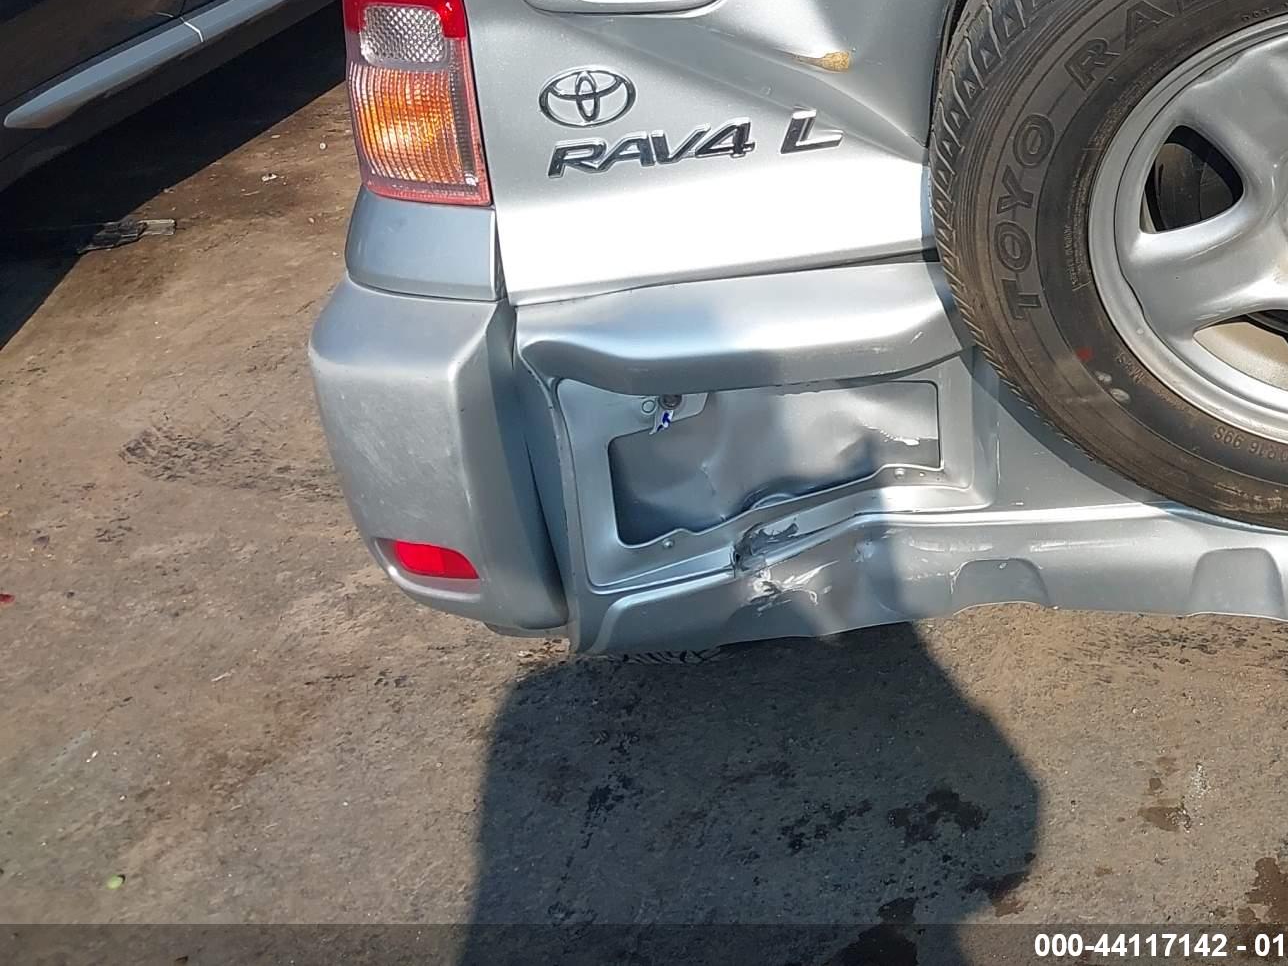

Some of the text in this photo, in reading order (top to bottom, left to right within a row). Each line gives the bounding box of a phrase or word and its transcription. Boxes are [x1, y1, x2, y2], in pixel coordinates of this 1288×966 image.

[547, 105, 845, 179] RAV4 L
[993, 113, 1055, 321] TOYO
